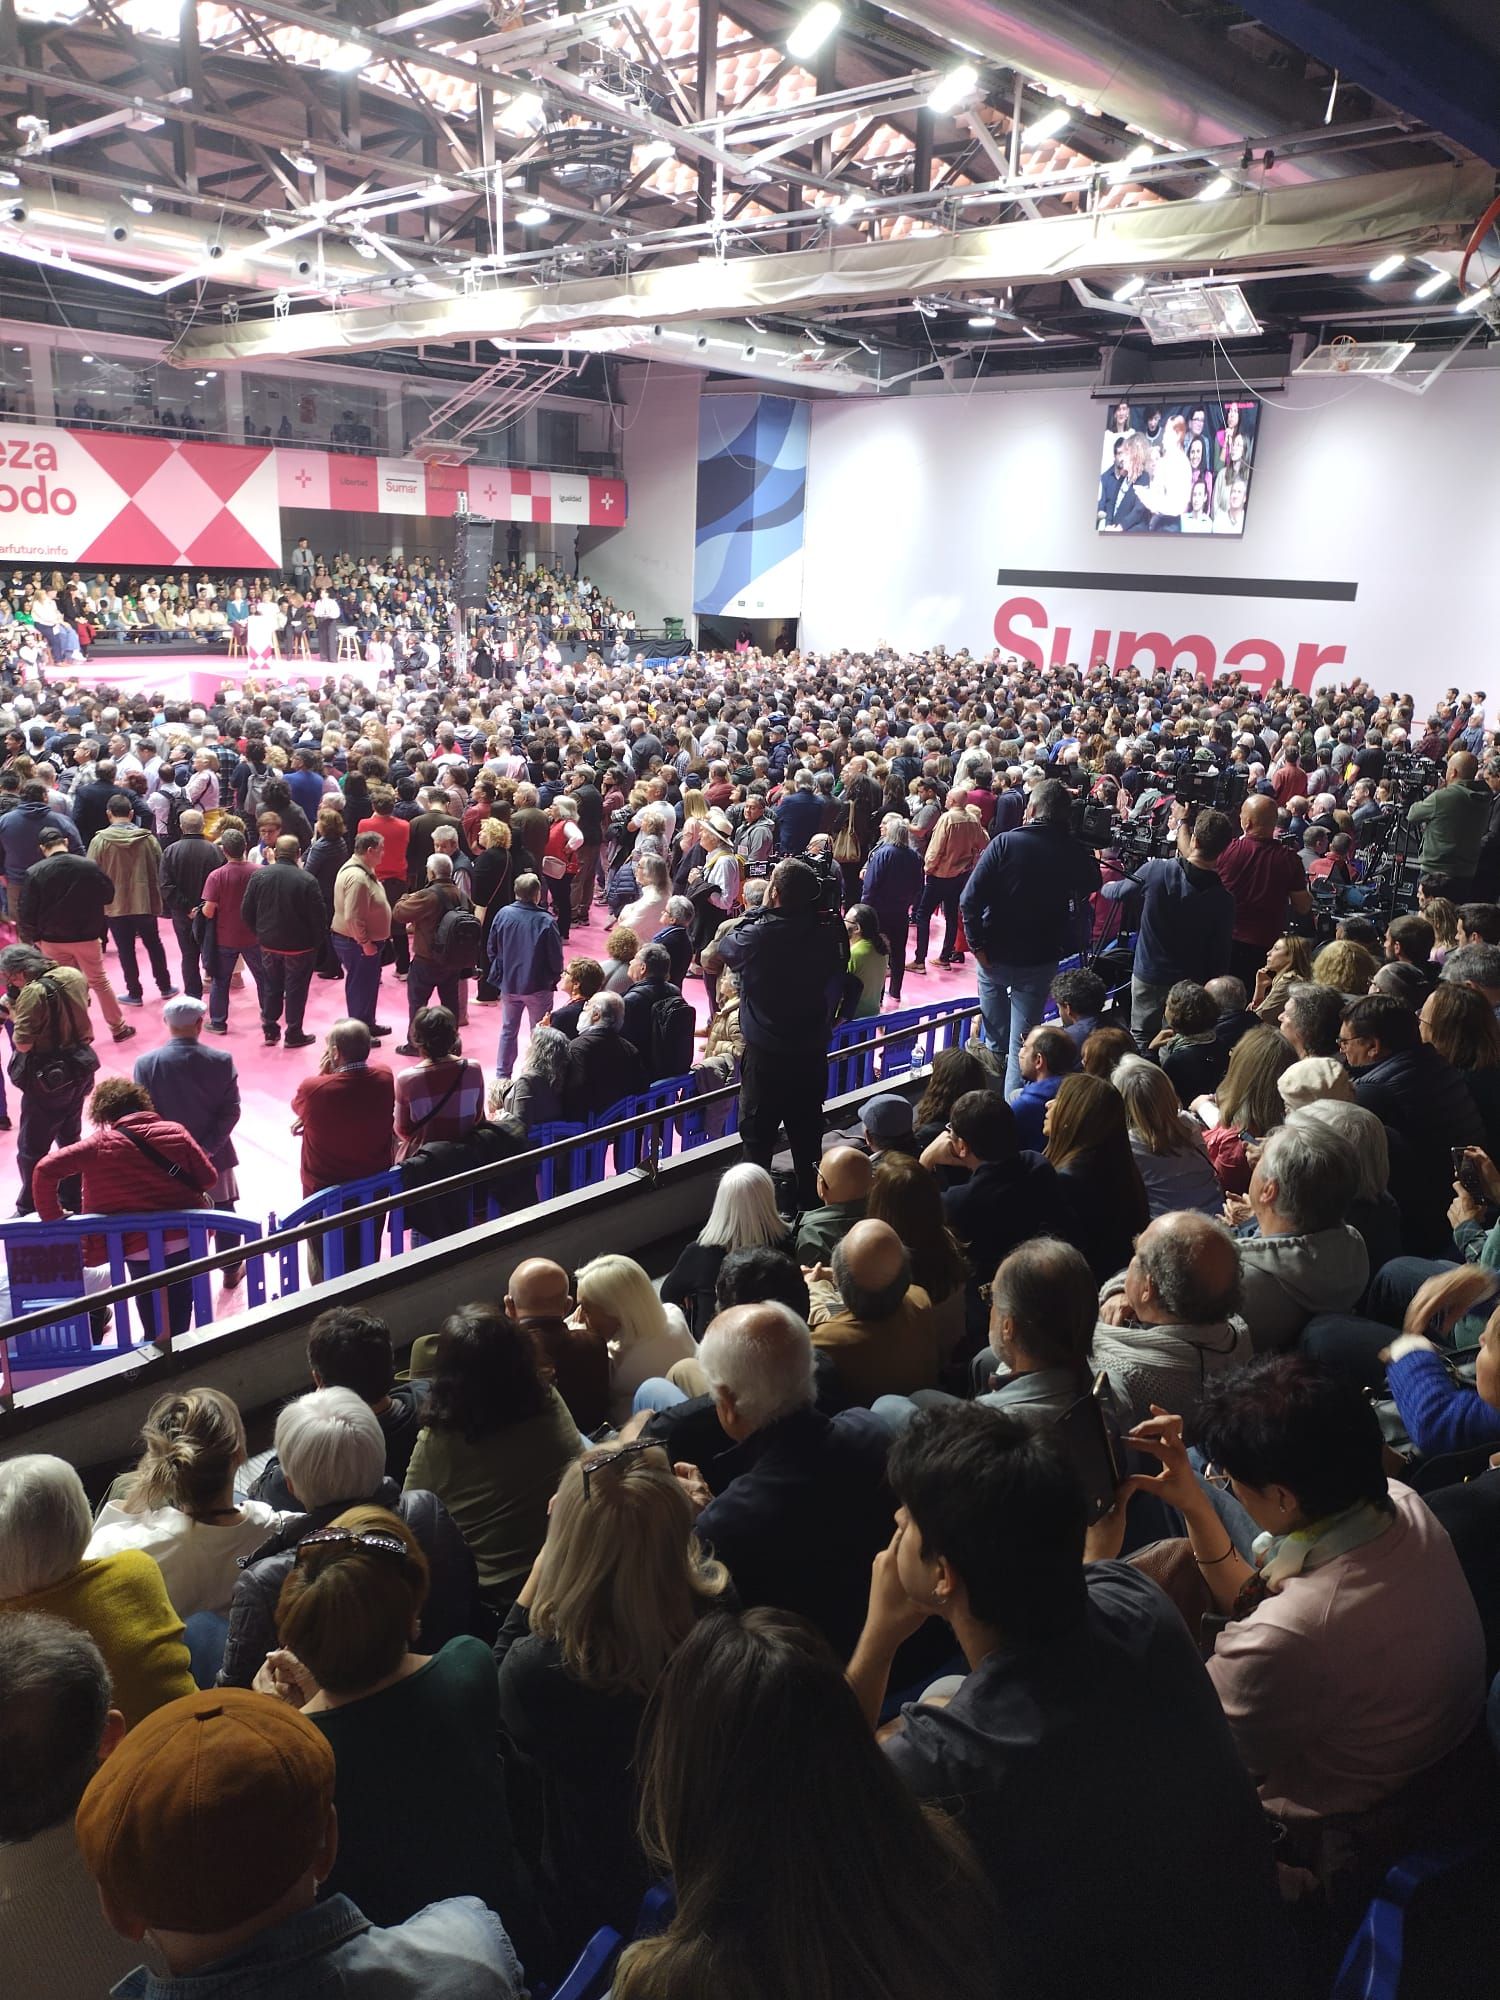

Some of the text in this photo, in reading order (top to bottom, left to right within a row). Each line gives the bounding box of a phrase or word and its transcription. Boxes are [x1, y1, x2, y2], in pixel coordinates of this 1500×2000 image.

[0, 475, 77, 515] odo
[385, 481, 417, 494] Sumar
[993, 597, 1347, 698] Sumar
